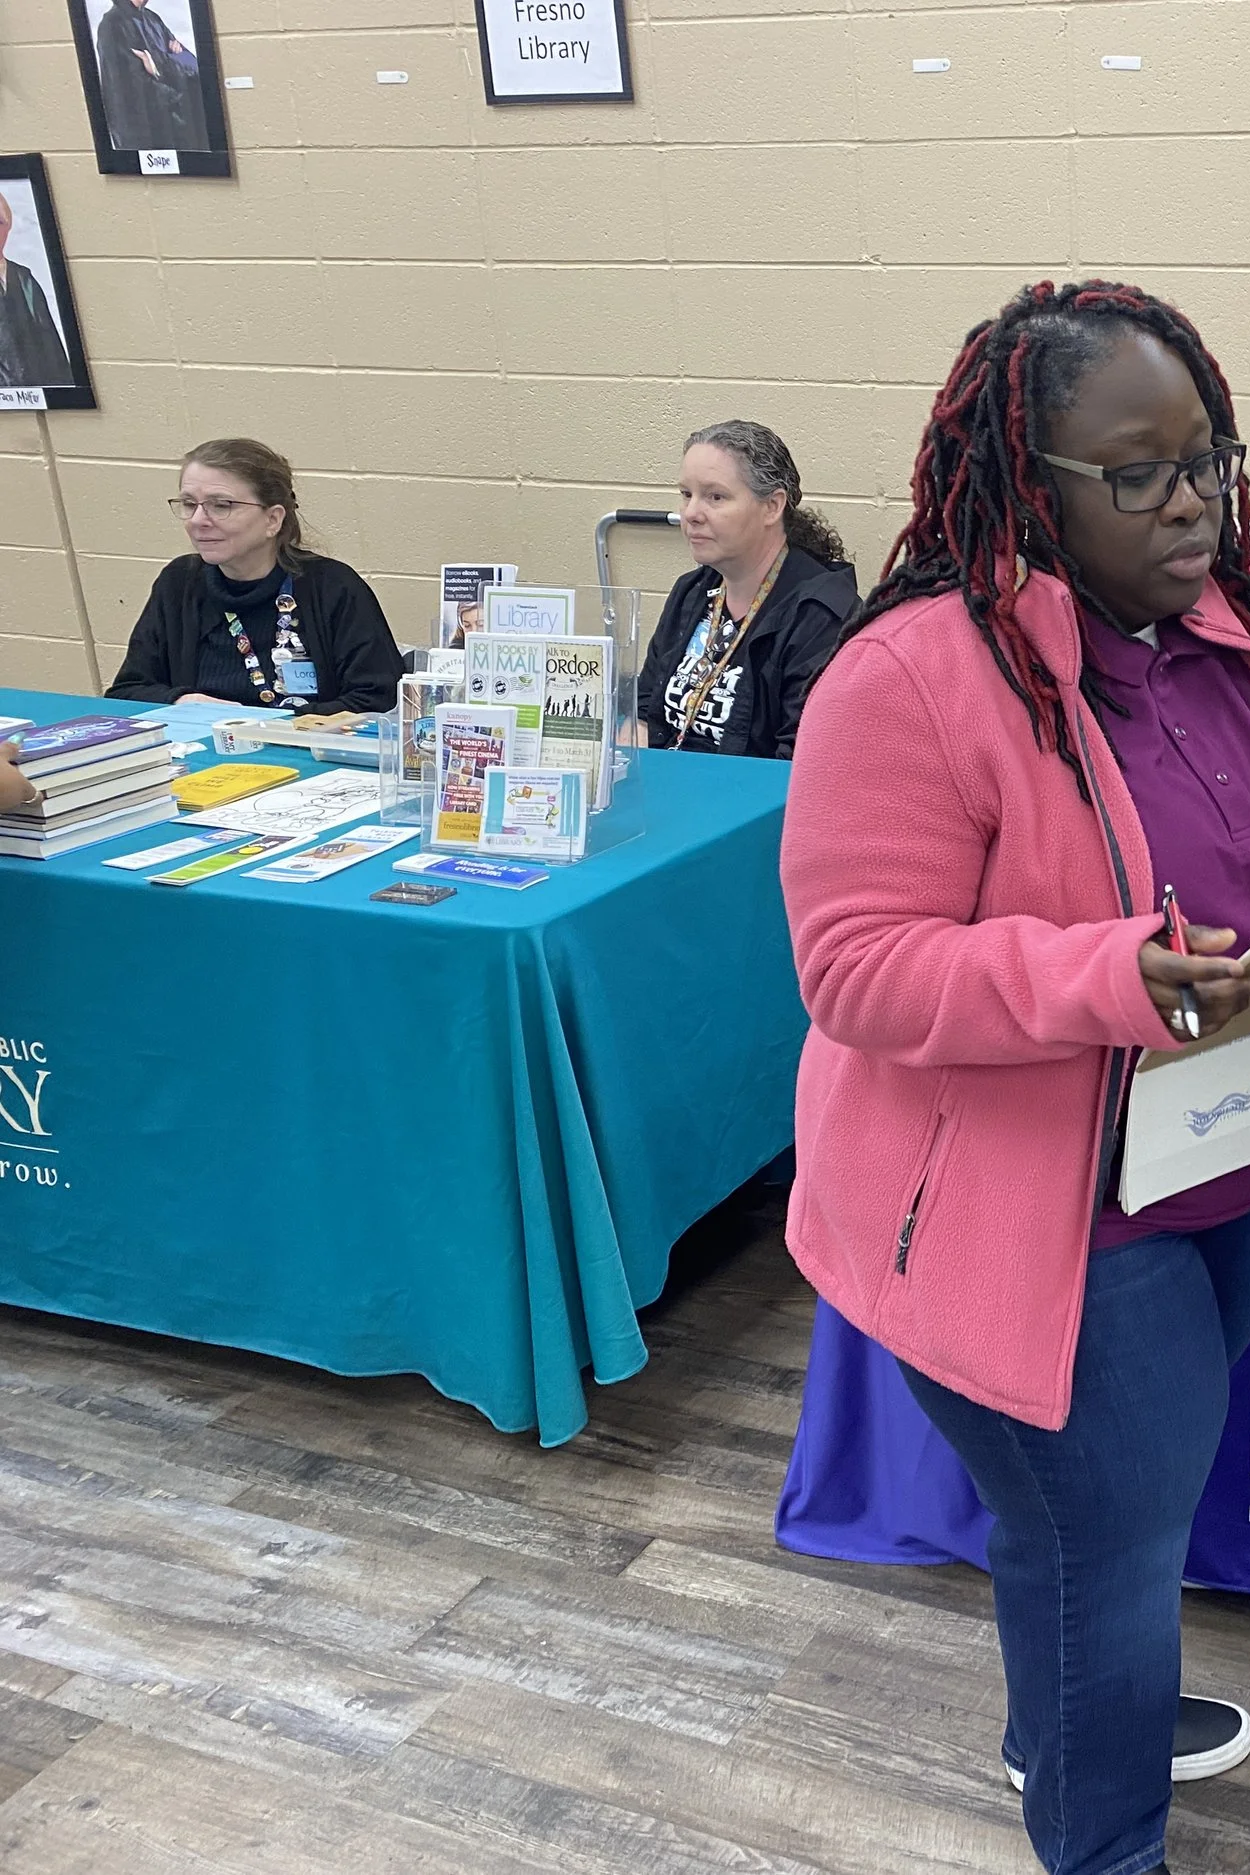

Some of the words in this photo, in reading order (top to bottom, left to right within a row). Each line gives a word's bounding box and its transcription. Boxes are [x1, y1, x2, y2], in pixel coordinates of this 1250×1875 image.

[514, 0, 585, 22] Fresno
[518, 35, 590, 64] Library
[146, 153, 171, 168] Snape
[497, 604, 559, 634] Library
[497, 644, 527, 656] BOOKS
[528, 646, 539, 656] BY
[496, 654, 541, 674] MAIL
[449, 738, 461, 746] THE
[461, 738, 487, 747] WORLD'S
[459, 750, 477, 758] FINEST
[477, 751, 499, 759] CINEMA
